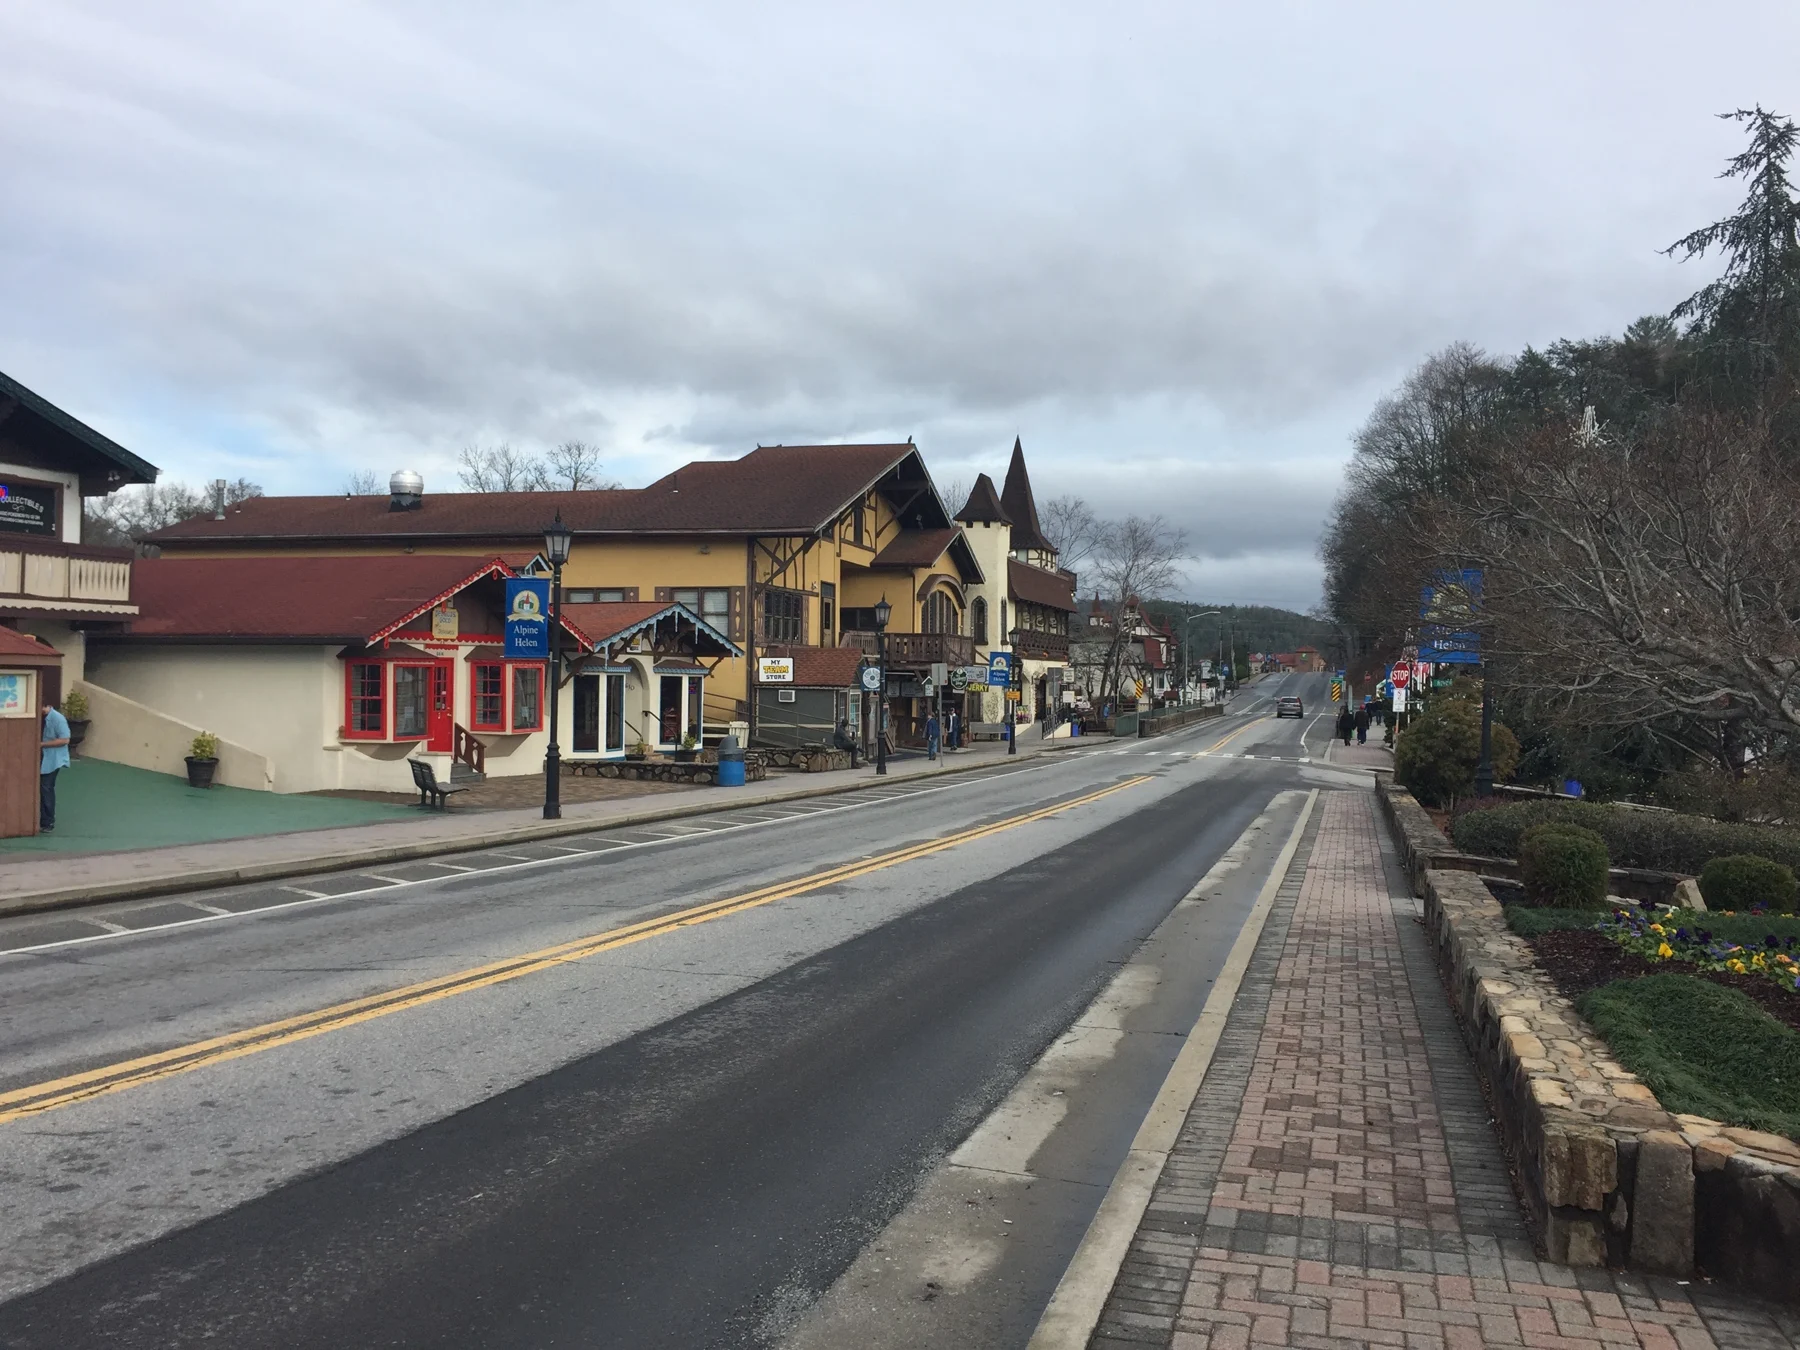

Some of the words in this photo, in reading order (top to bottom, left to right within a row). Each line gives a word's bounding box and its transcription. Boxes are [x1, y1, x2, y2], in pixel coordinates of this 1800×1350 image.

[513, 625, 539, 636] Alpine
[514, 638, 538, 647] Helen
[763, 665, 789, 674] TEAM
[1393, 670, 1409, 680] STOP
[968, 684, 988, 692] JERKY
